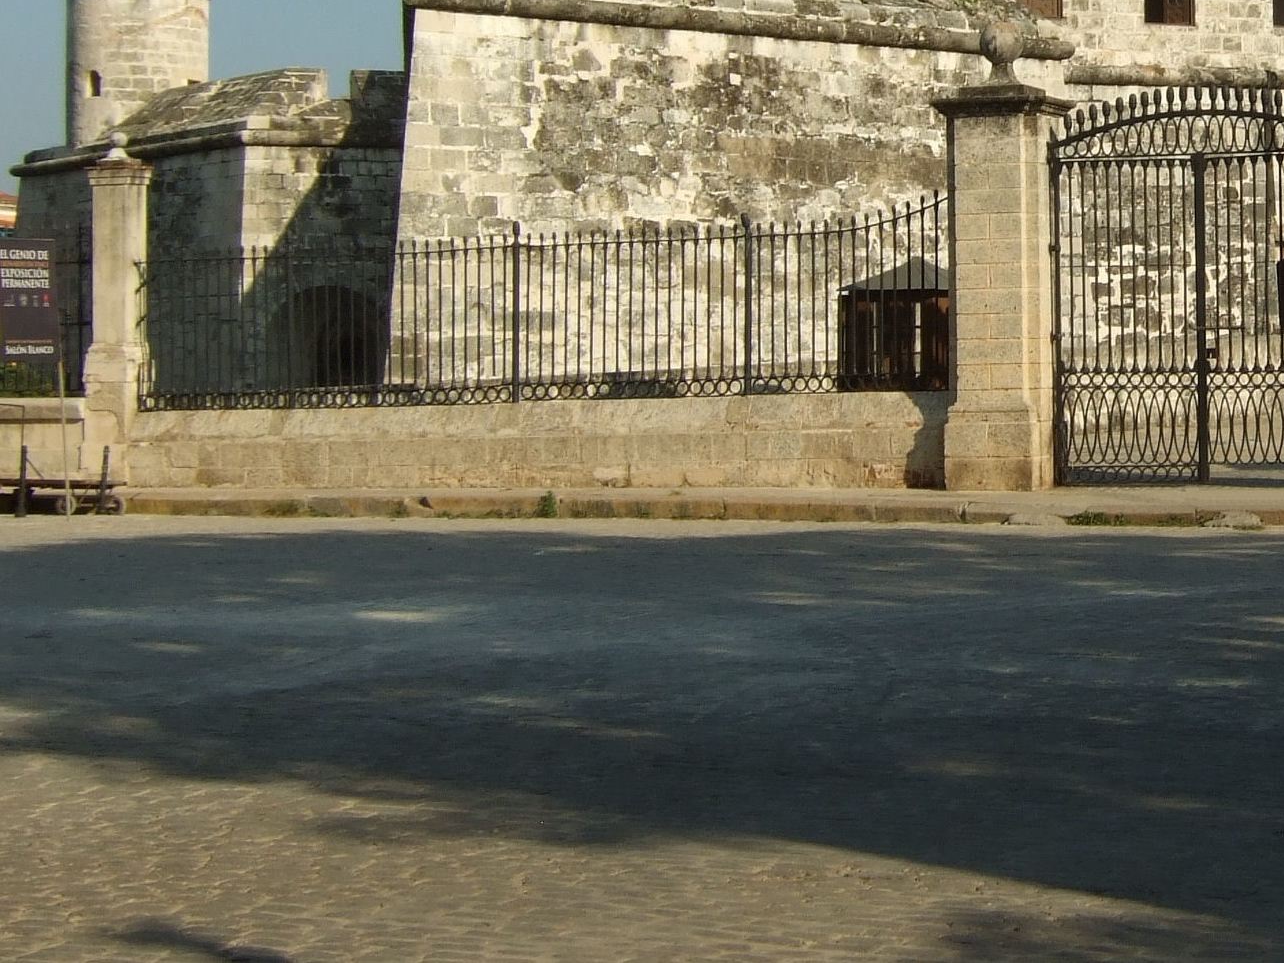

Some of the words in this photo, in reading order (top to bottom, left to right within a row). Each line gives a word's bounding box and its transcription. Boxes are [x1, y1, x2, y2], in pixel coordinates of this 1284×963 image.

[10, 249, 36, 260] GENIO
[38, 250, 49, 260] DE
[1, 268, 49, 278] EXPOSICIÓN
[2, 279, 50, 288] PERMANENTE
